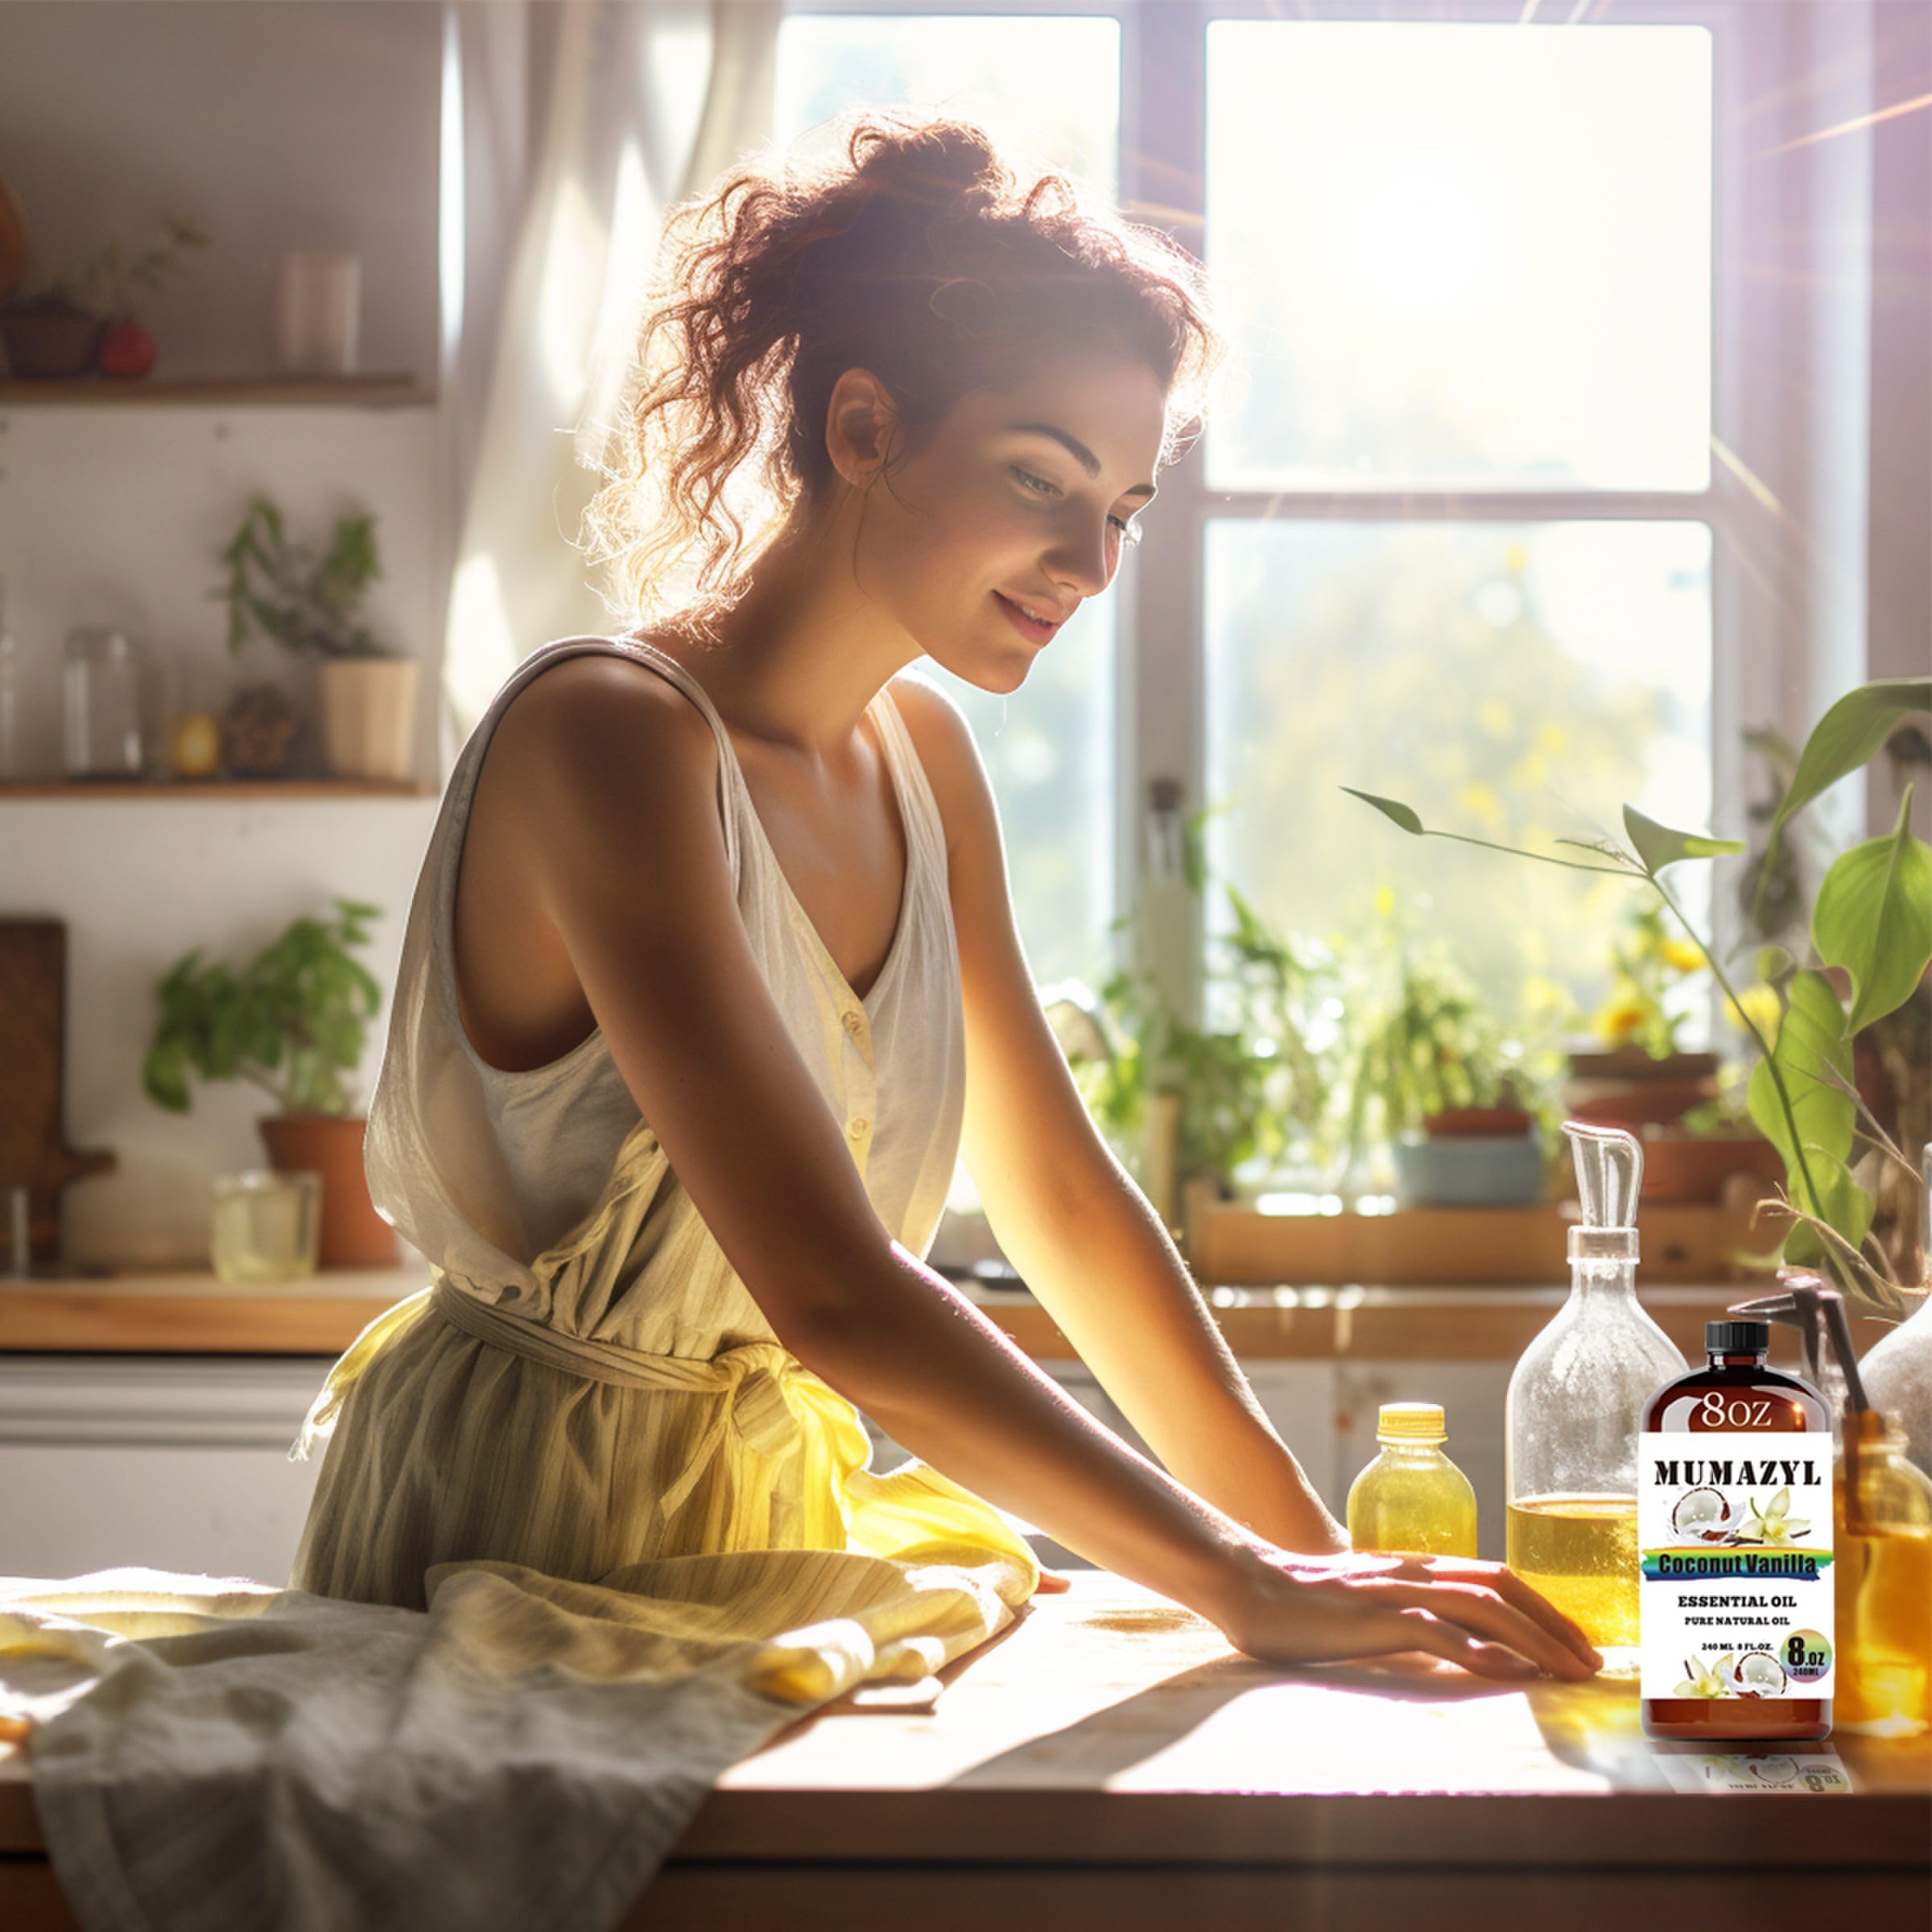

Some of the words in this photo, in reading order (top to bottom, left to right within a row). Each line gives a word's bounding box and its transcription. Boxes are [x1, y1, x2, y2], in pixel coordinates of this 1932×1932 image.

[1654, 1460, 1821, 1486] MUMAZYL
[1659, 1554, 1743, 1574] Coconut
[1745, 1554, 1816, 1574] Vanilla
[1678, 1596, 1769, 1608] ESSENTIAL
[1770, 1596, 1798, 1608] OIL
[1684, 1616, 1714, 1625] PURE
[1715, 1616, 1770, 1625] NATURAL
[1771, 1616, 1791, 1625] OIL
[1701, 1642, 1719, 1651] 240
[1719, 1642, 1735, 1651] ML
